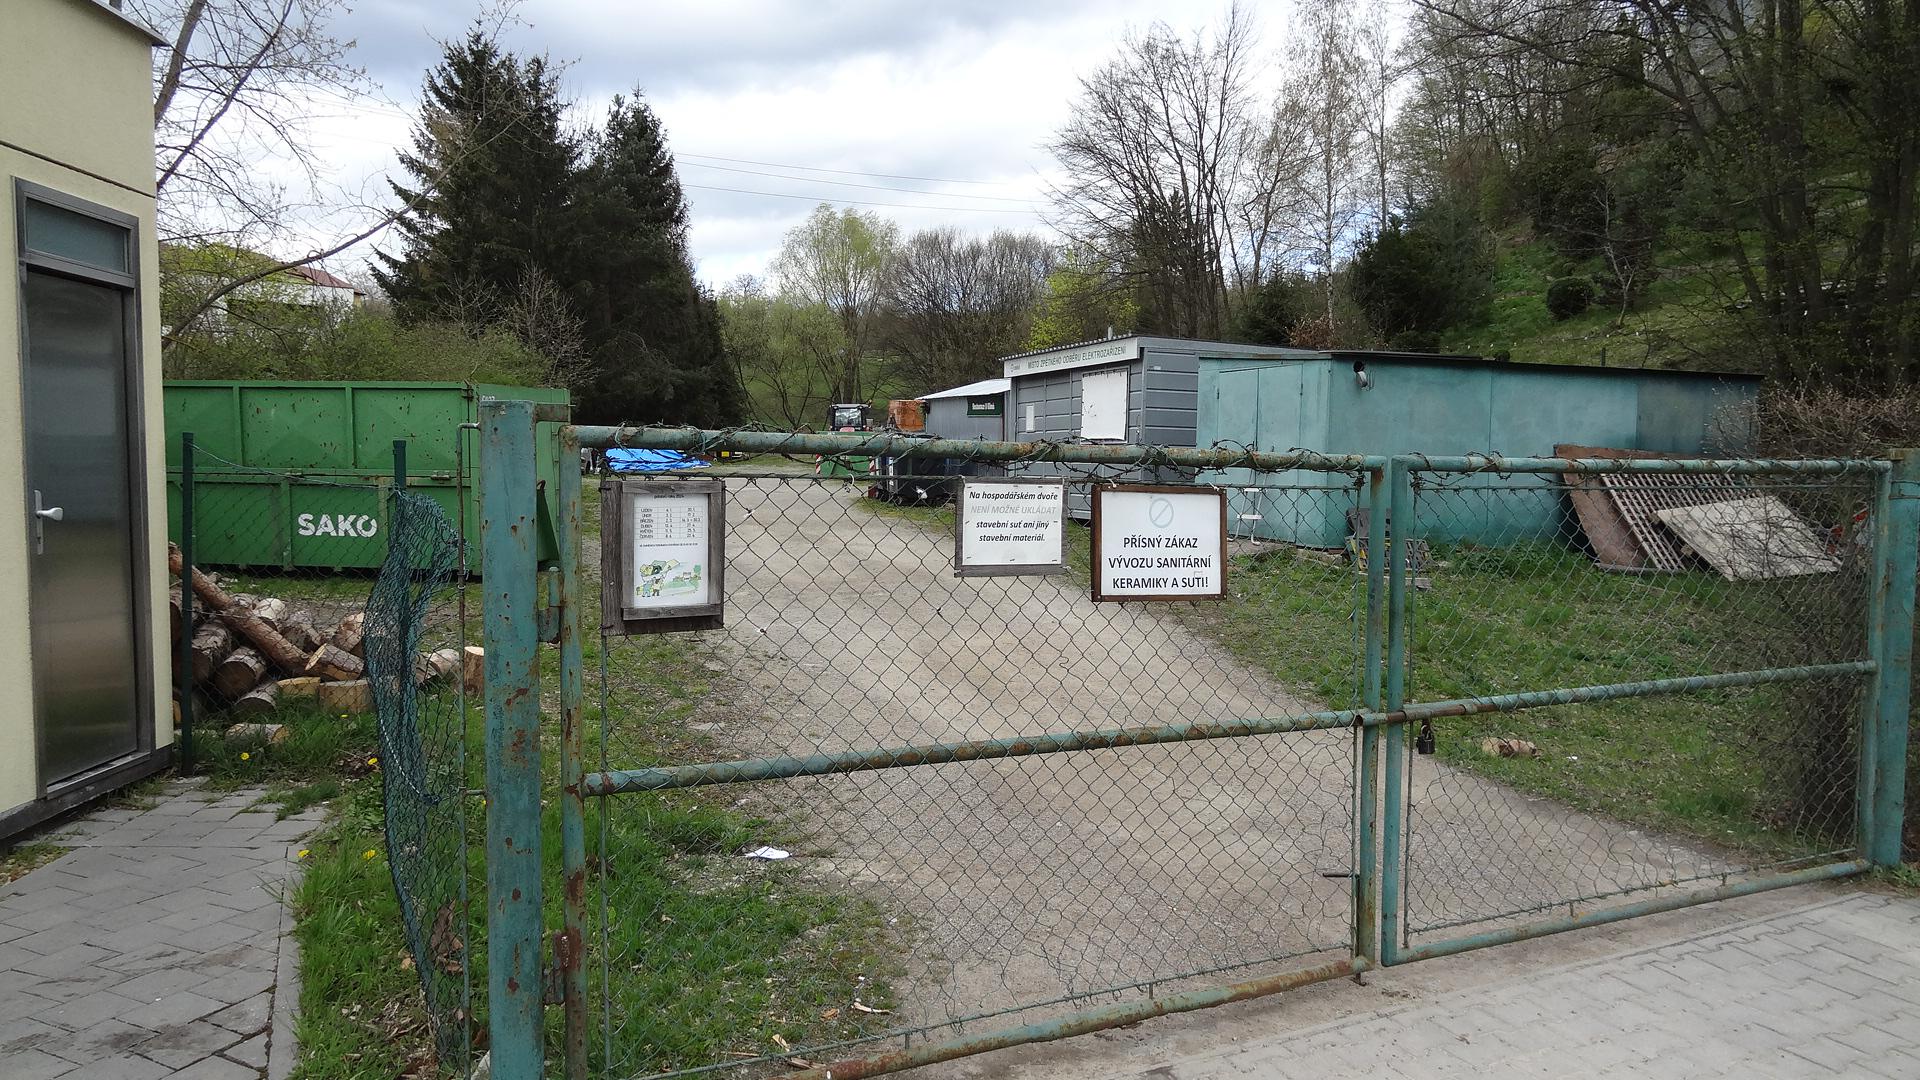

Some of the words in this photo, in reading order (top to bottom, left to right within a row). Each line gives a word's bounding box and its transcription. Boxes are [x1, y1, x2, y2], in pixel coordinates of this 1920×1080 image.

[1063, 353, 1081, 364] ODBĚRU
[1082, 346, 1126, 360] ELEKTROZAŘÍZENÍ
[969, 491, 980, 500] Na
[982, 490, 1036, 502] hospodářském
[1037, 491, 1058, 500] dvoře
[971, 505, 990, 514] NENÍ
[992, 504, 1020, 514] MOŽNÉ
[1021, 505, 1056, 514] UKLÁDAT
[298, 513, 377, 538] SAKO
[976, 519, 1009, 529] stavební
[1010, 520, 1022, 529] suť
[1023, 520, 1034, 529] ani
[1035, 520, 1049, 530] jiný
[979, 533, 1011, 542] stavební
[1013, 533, 1045, 542] materiál.
[1124, 535, 1162, 548] PŘÍSNÝ
[1165, 535, 1198, 548] ZÁKAZ
[1109, 555, 1153, 568] VÝVOZU
[1156, 555, 1211, 568] SANITÁRNÍ
[1113, 578, 1168, 589] KERAMIKY
[1171, 578, 1179, 588] A
[1181, 576, 1208, 588] SUTI!
